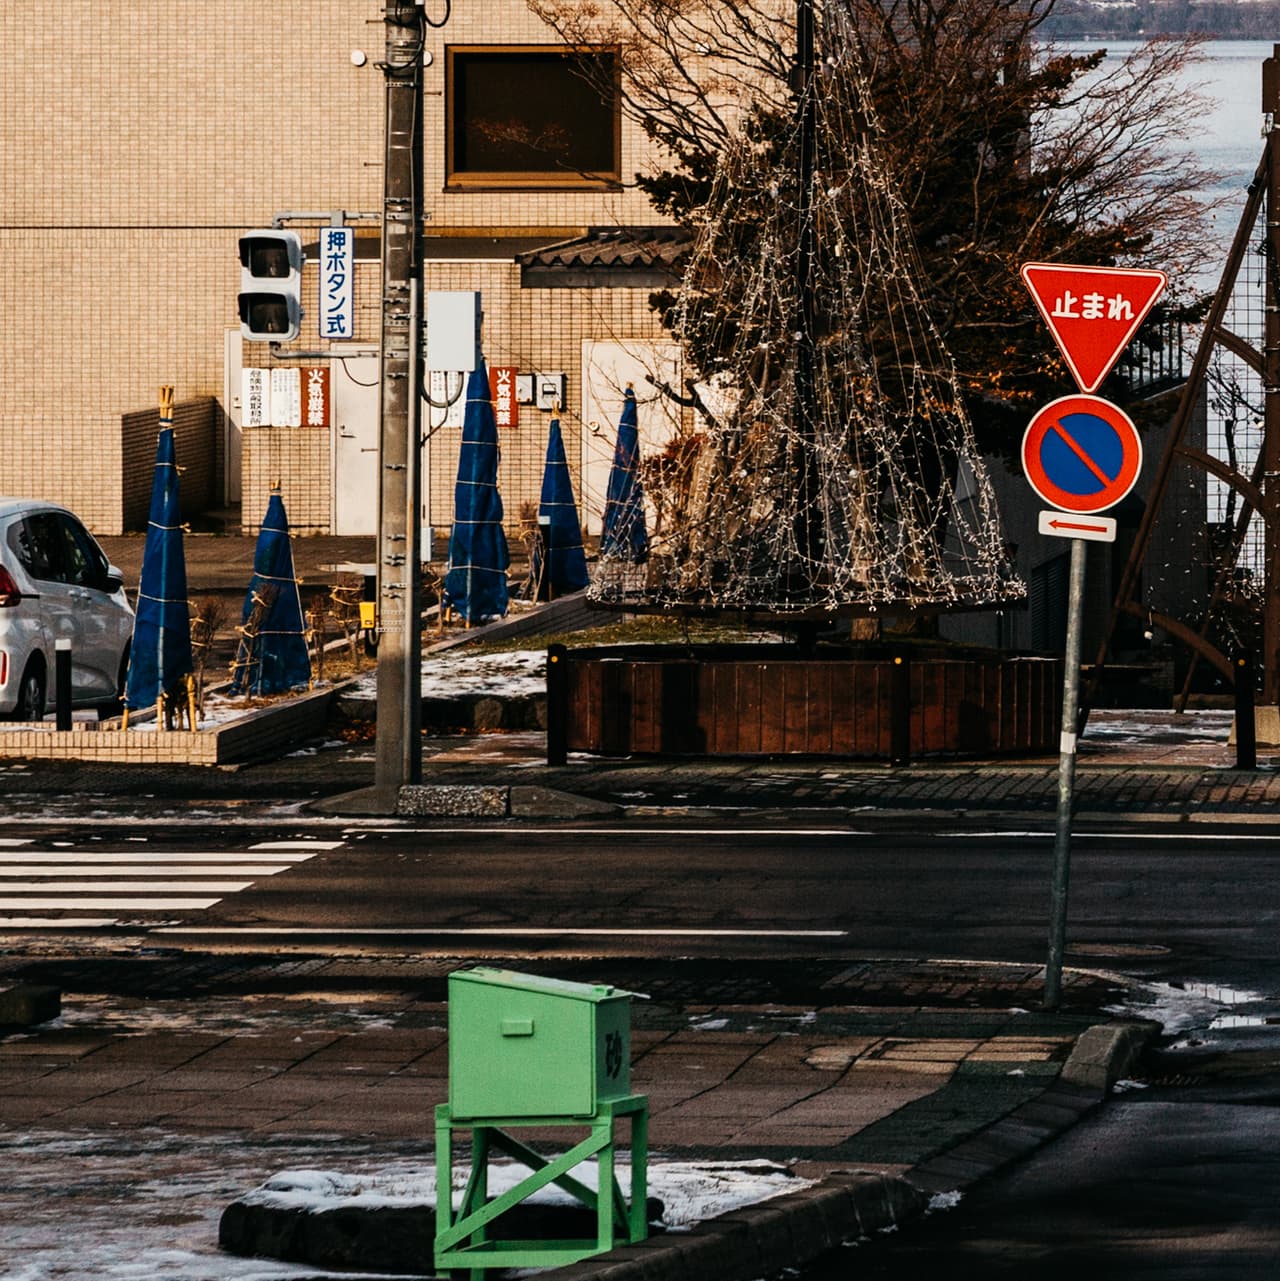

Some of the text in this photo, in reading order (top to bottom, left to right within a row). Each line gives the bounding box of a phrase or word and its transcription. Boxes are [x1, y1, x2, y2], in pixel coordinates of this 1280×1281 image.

[326, 231, 346, 334] 押ボタン式
[1051, 290, 1135, 320] 止まれ
[307, 369, 324, 426] 火気厳禁
[497, 369, 511, 425] 火気厳禁
